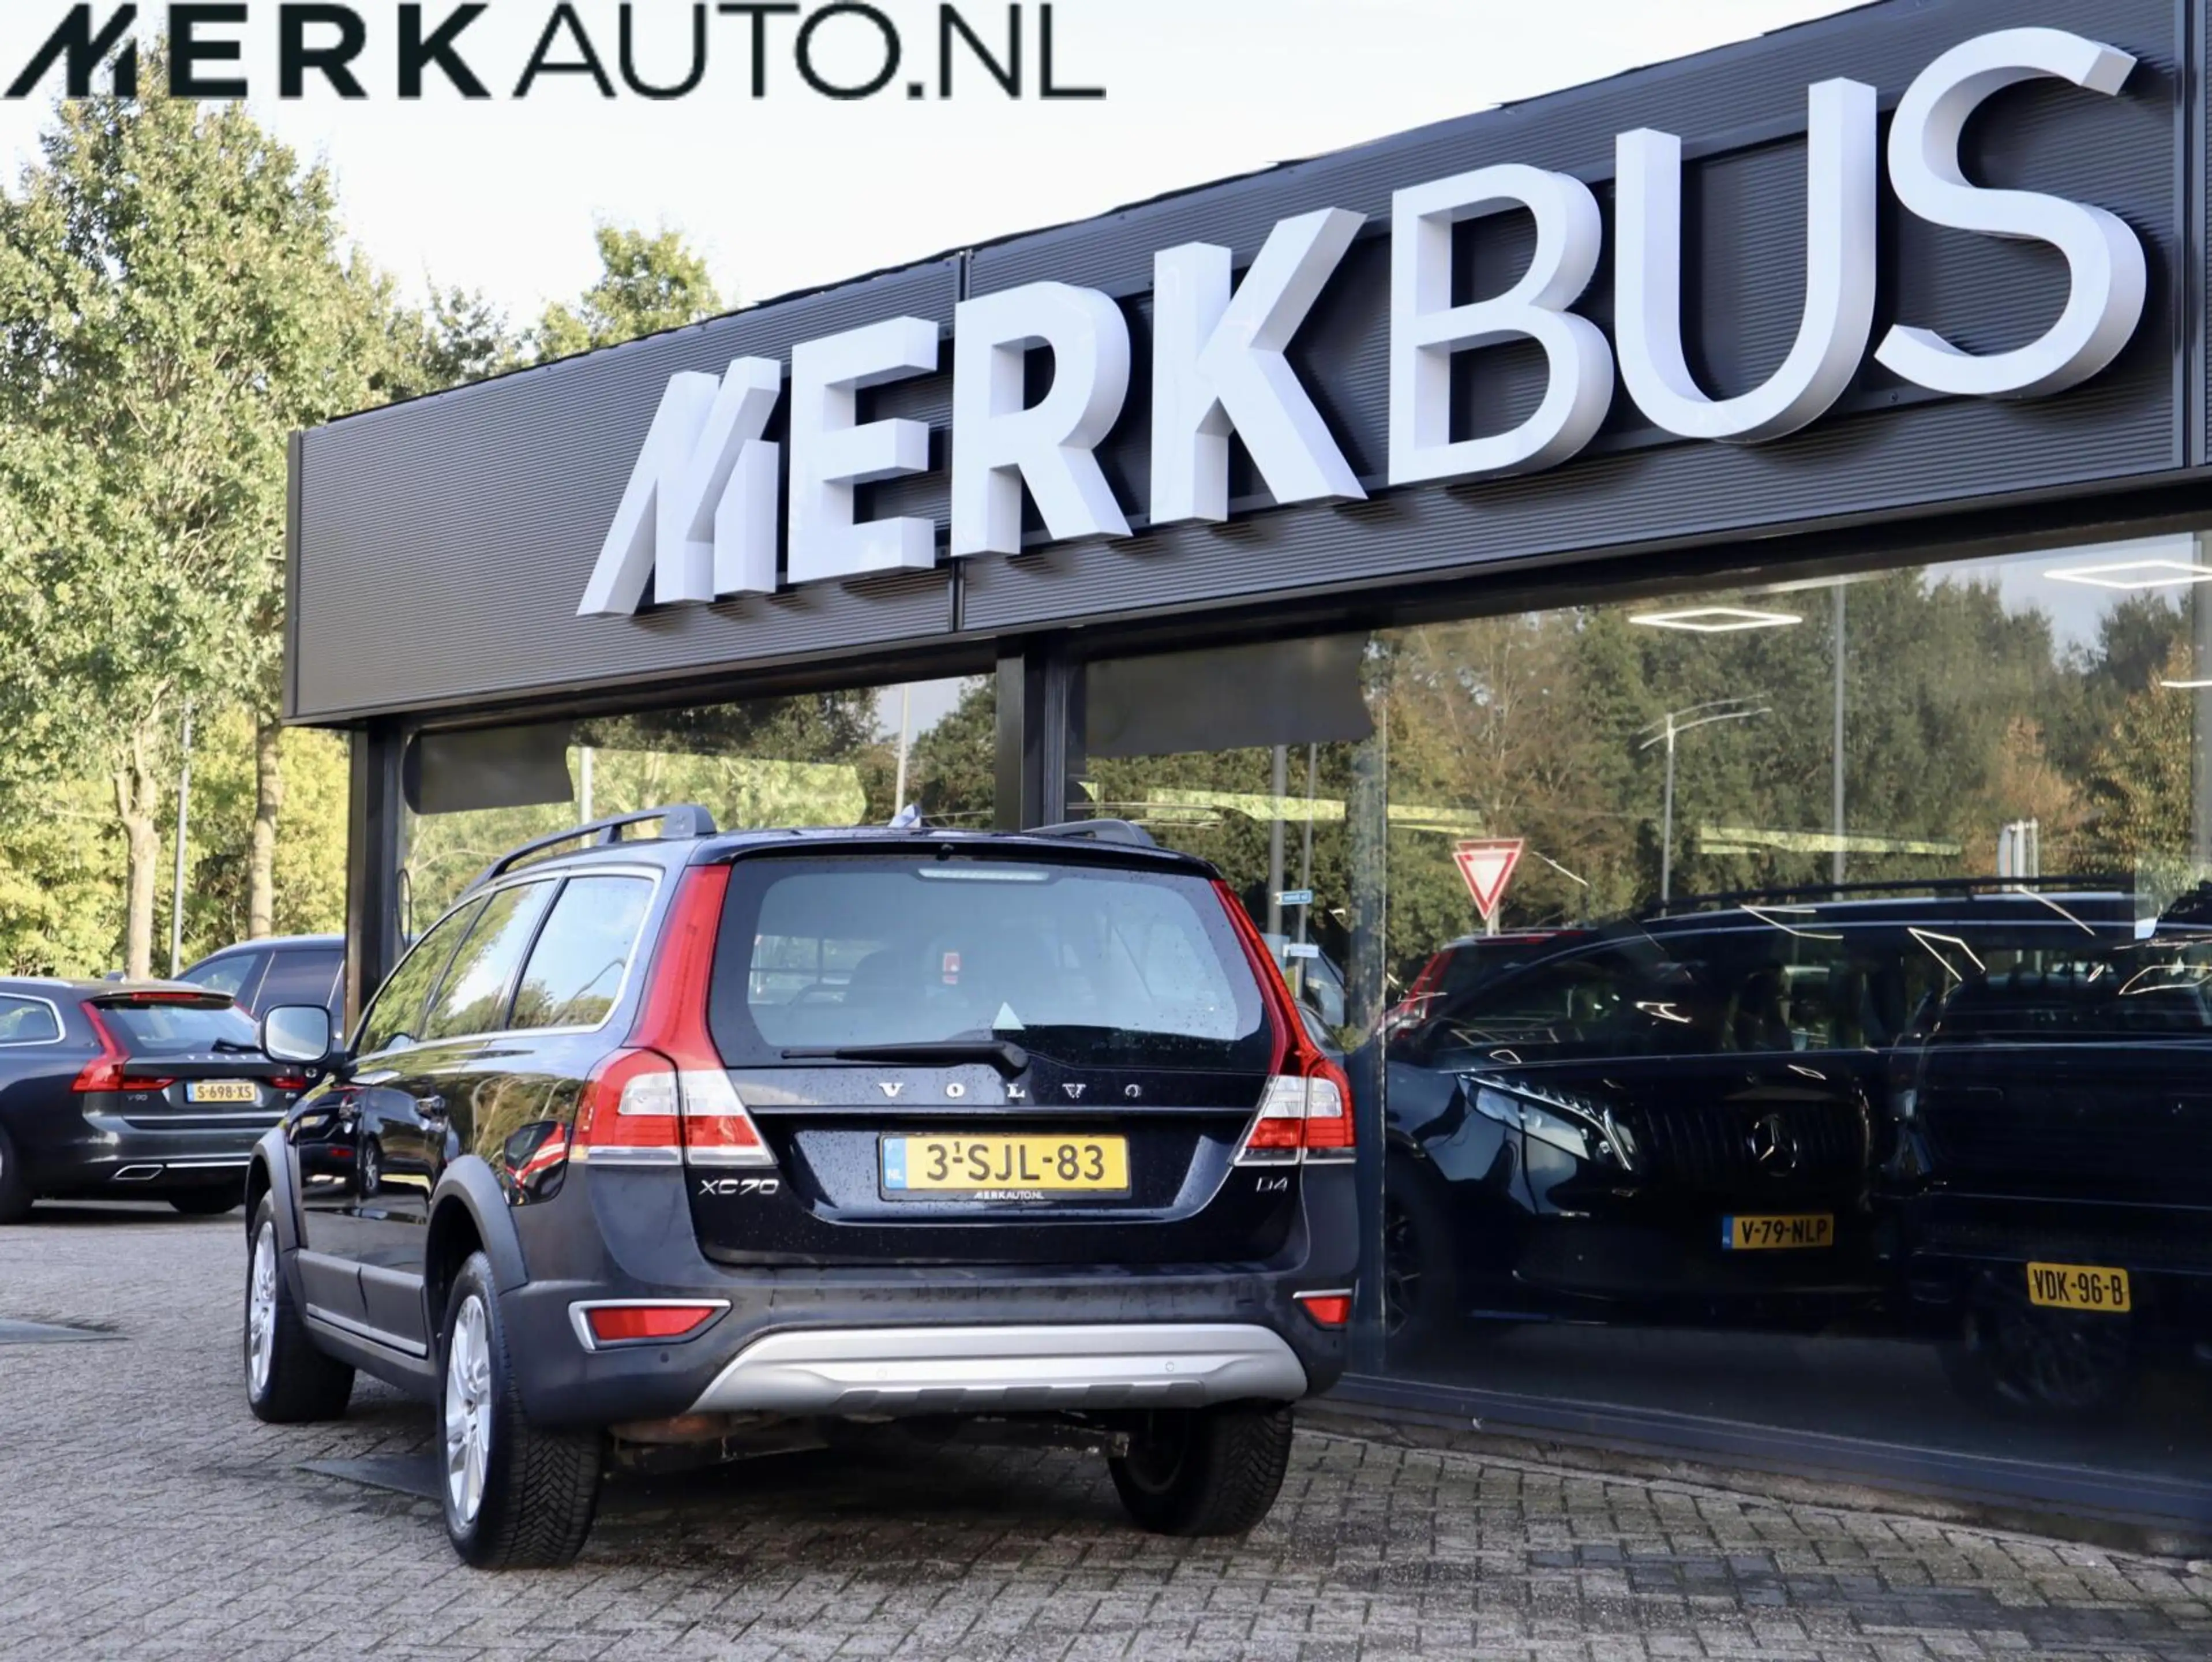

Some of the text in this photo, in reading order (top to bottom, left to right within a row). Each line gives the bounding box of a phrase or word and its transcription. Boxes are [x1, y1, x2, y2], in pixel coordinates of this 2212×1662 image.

[579, 28, 2147, 619] MERKBUS
[879, 1083, 1141, 1098] VOLVO
[698, 1178, 779, 1195] XC70
[1742, 1219, 1827, 1244] V-79-NLP
[2033, 1269, 2123, 1306] VDK-96-B
